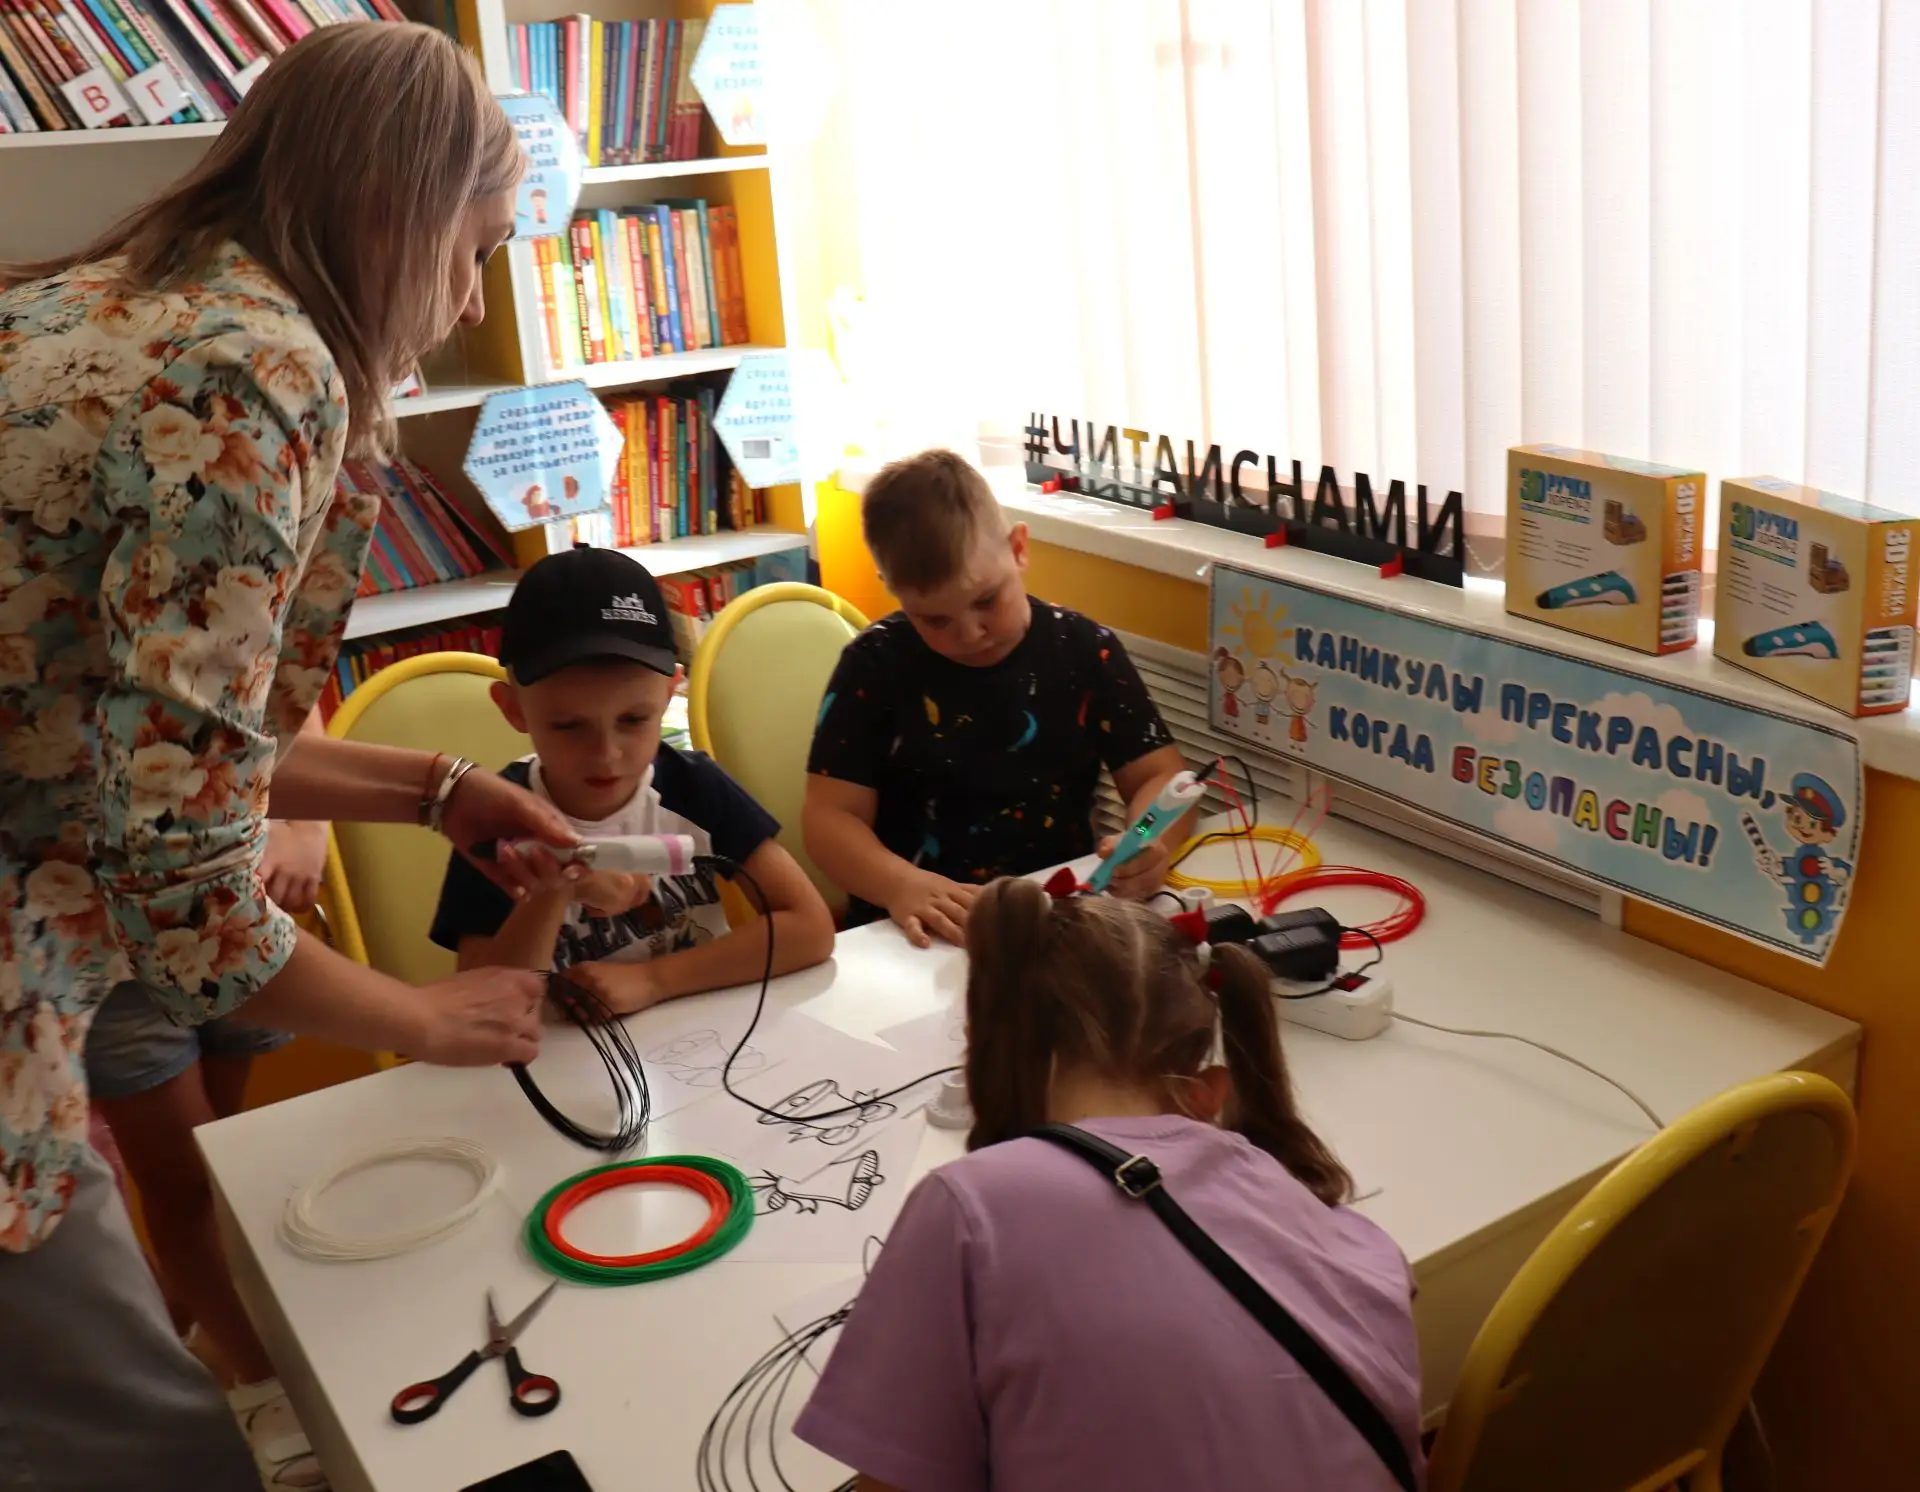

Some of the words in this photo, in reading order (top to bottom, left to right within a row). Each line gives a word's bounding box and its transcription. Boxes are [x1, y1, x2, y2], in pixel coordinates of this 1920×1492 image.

[81, 85, 109, 113] В
[145, 79, 165, 107] Г
[1294, 626, 1483, 715] КАНИКУЛЫ
[1501, 684, 1777, 809] ПРЕКРАСНЫ,
[1329, 704, 1435, 773] КОГДА
[1451, 745, 1720, 868] БЕЗОПАСНЫ!
